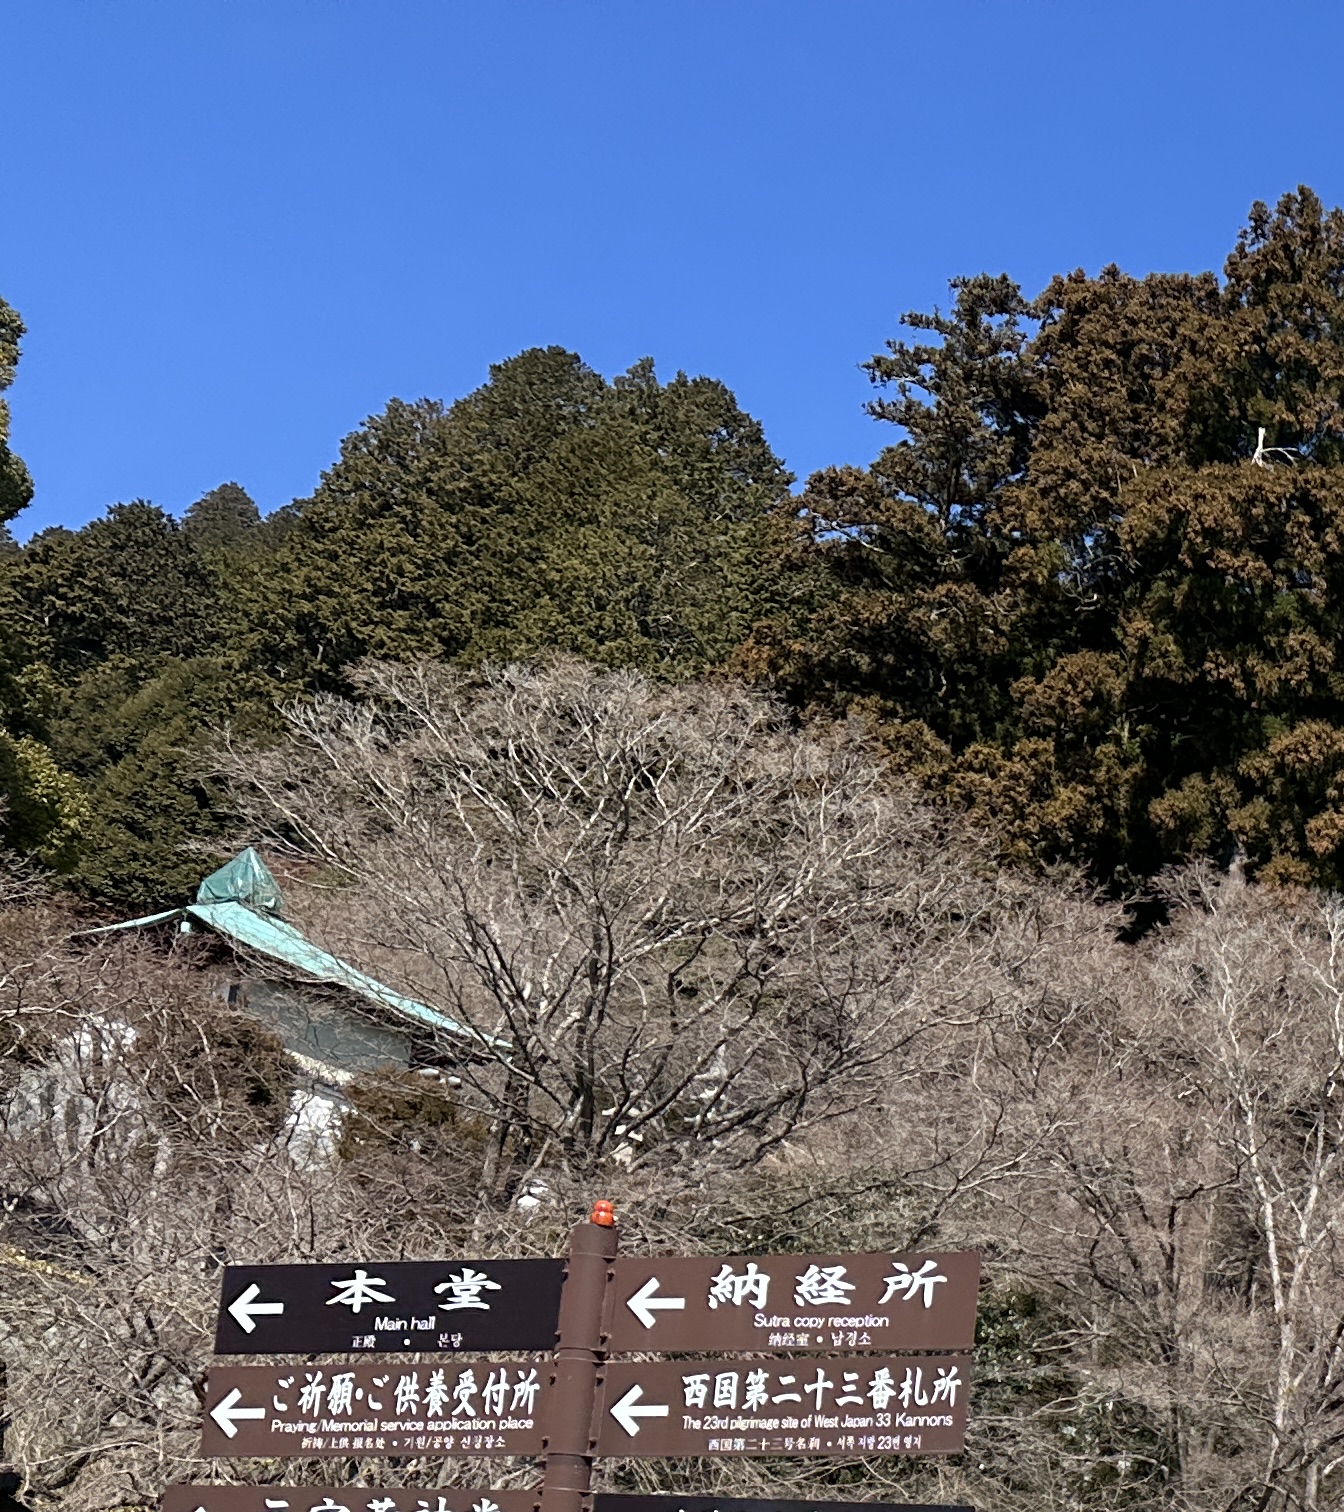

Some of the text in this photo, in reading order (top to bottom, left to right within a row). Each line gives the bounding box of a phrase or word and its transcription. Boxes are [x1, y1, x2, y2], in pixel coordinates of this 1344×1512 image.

[326, 1268, 501, 1312] 本堂
[708, 1261, 947, 1309] 納経所
[375, 1316, 435, 1330] Main hall
[754, 1313, 889, 1328] Sutra copy reception
[682, 1367, 962, 1410] 西国第二十三番札所
[271, 1415, 534, 1433] Praying/Memorial service application place
[683, 1413, 953, 1430] The 23rd pilgrimage site of West Japan 33 Kannons
